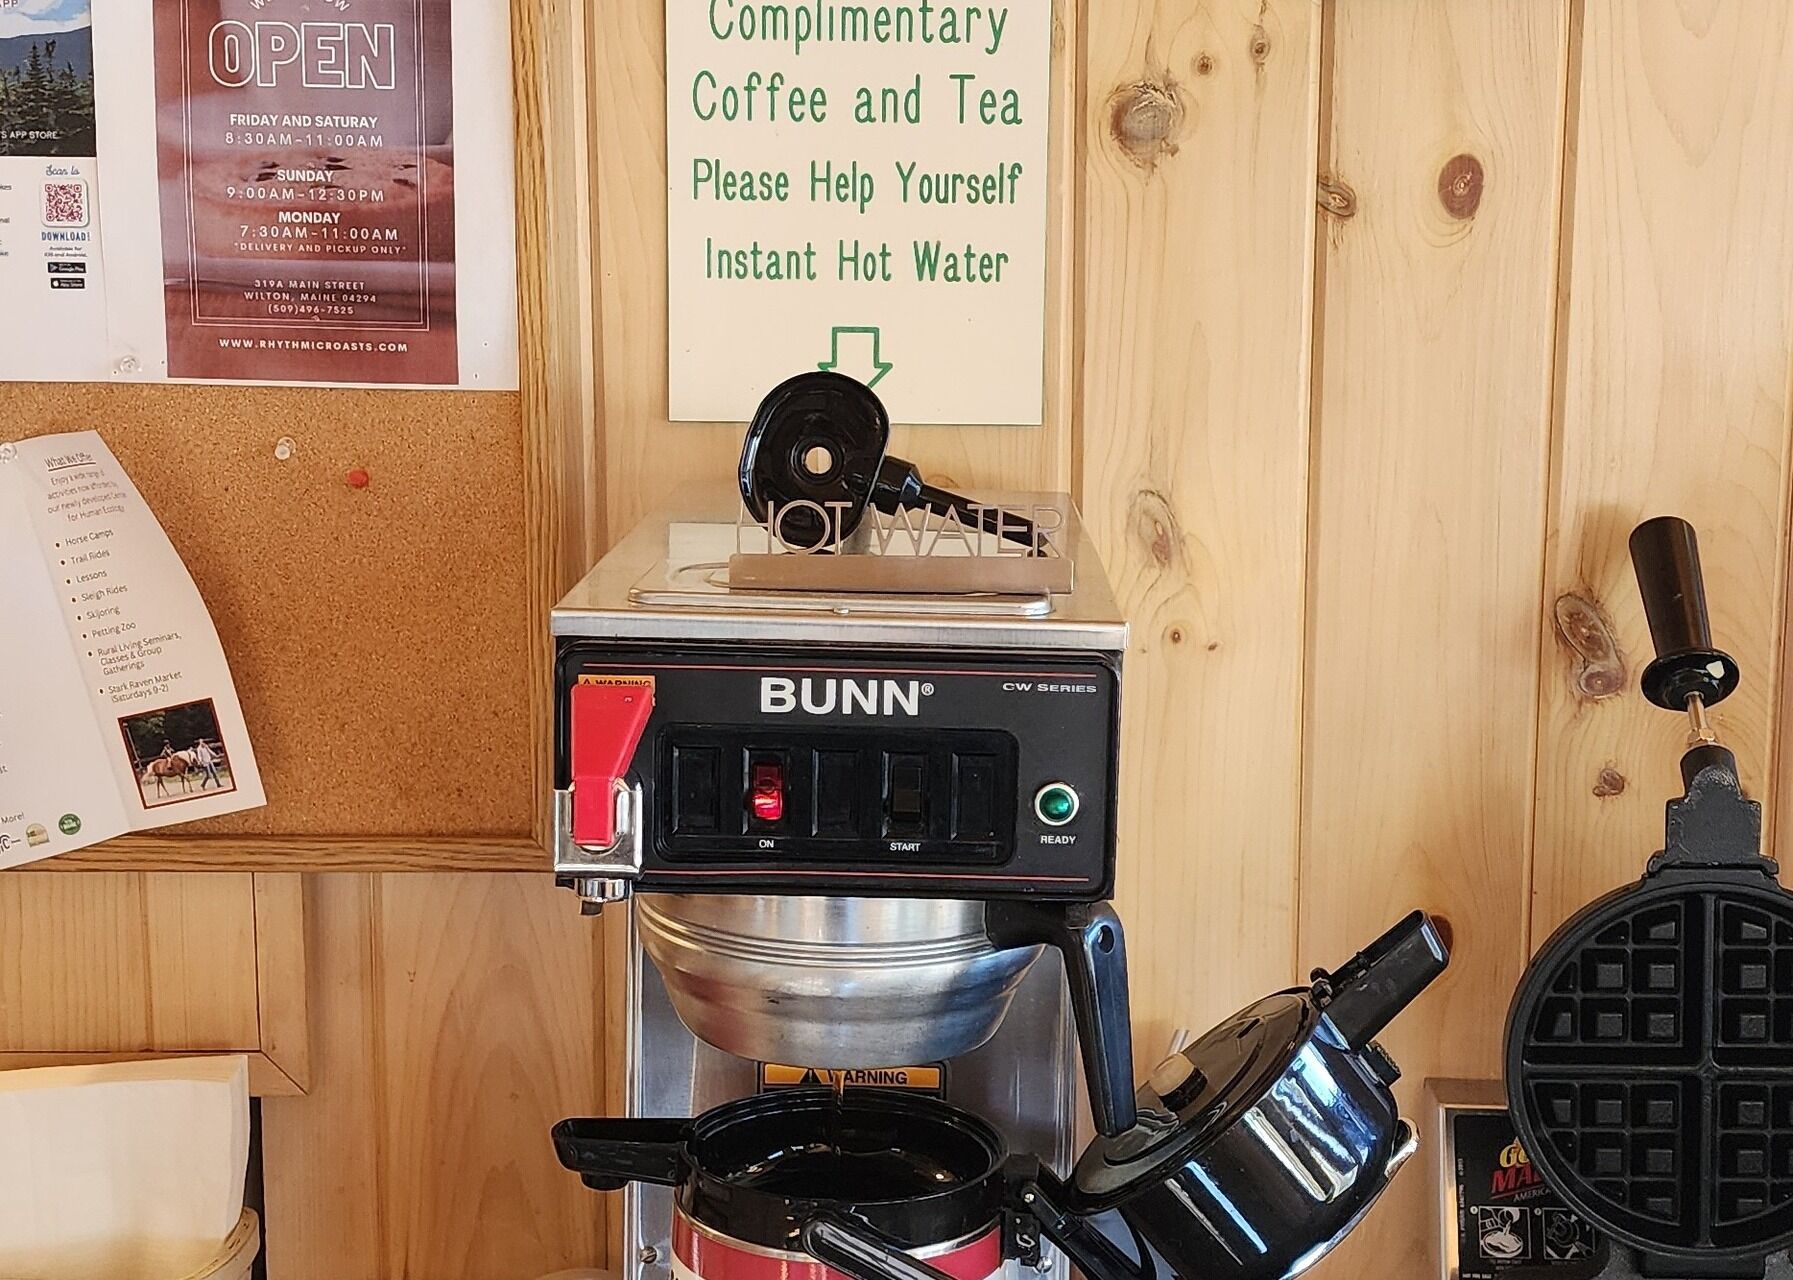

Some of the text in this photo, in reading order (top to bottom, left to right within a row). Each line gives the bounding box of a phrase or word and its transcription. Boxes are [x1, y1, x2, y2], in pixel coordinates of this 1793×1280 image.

[209, 20, 396, 89] OPEN
[693, 70, 1022, 125] Coffee and Tea
[230, 114, 378, 128] FRIDAY AND SATURAY
[29, 131, 57, 139] STORE
[225, 132, 383, 147] 8:30AM-11:00AM
[277, 170, 333, 182] SUNDAY
[693, 159, 1022, 213] Please Help Yourself
[227, 187, 384, 201] 9:00AM-12:30PM
[278, 212, 340, 224] MONDAY
[240, 226, 398, 240] 7:30AM-11:00AM
[299, 244, 320, 252] AND
[326, 245, 366, 253] PICKUP
[706, 238, 1009, 283] Instant Hot Water
[254, 280, 365, 290] 319A MAIN STREET
[244, 292, 294, 302] WILTON,
[342, 294, 376, 302] 04294
[268, 305, 354, 315] (509)496-7525
[219, 339, 408, 352] WWW.RHYTHMICROASTS.COM
[736, 499, 1066, 559] HOT WATER
[66, 529, 114, 546] Horse Camps
[77, 570, 107, 583] Lessons
[82, 585, 128, 601] Sleigh Rides
[87, 607, 120, 619] Skijoring
[92, 623, 136, 638] Petting Zoo
[109, 672, 182, 693] Stark Raven Market
[1003, 683, 1096, 693] CW SERIES
[759, 840, 774, 848] ON
[1041, 835, 1076, 845] READY
[890, 843, 920, 852] START
